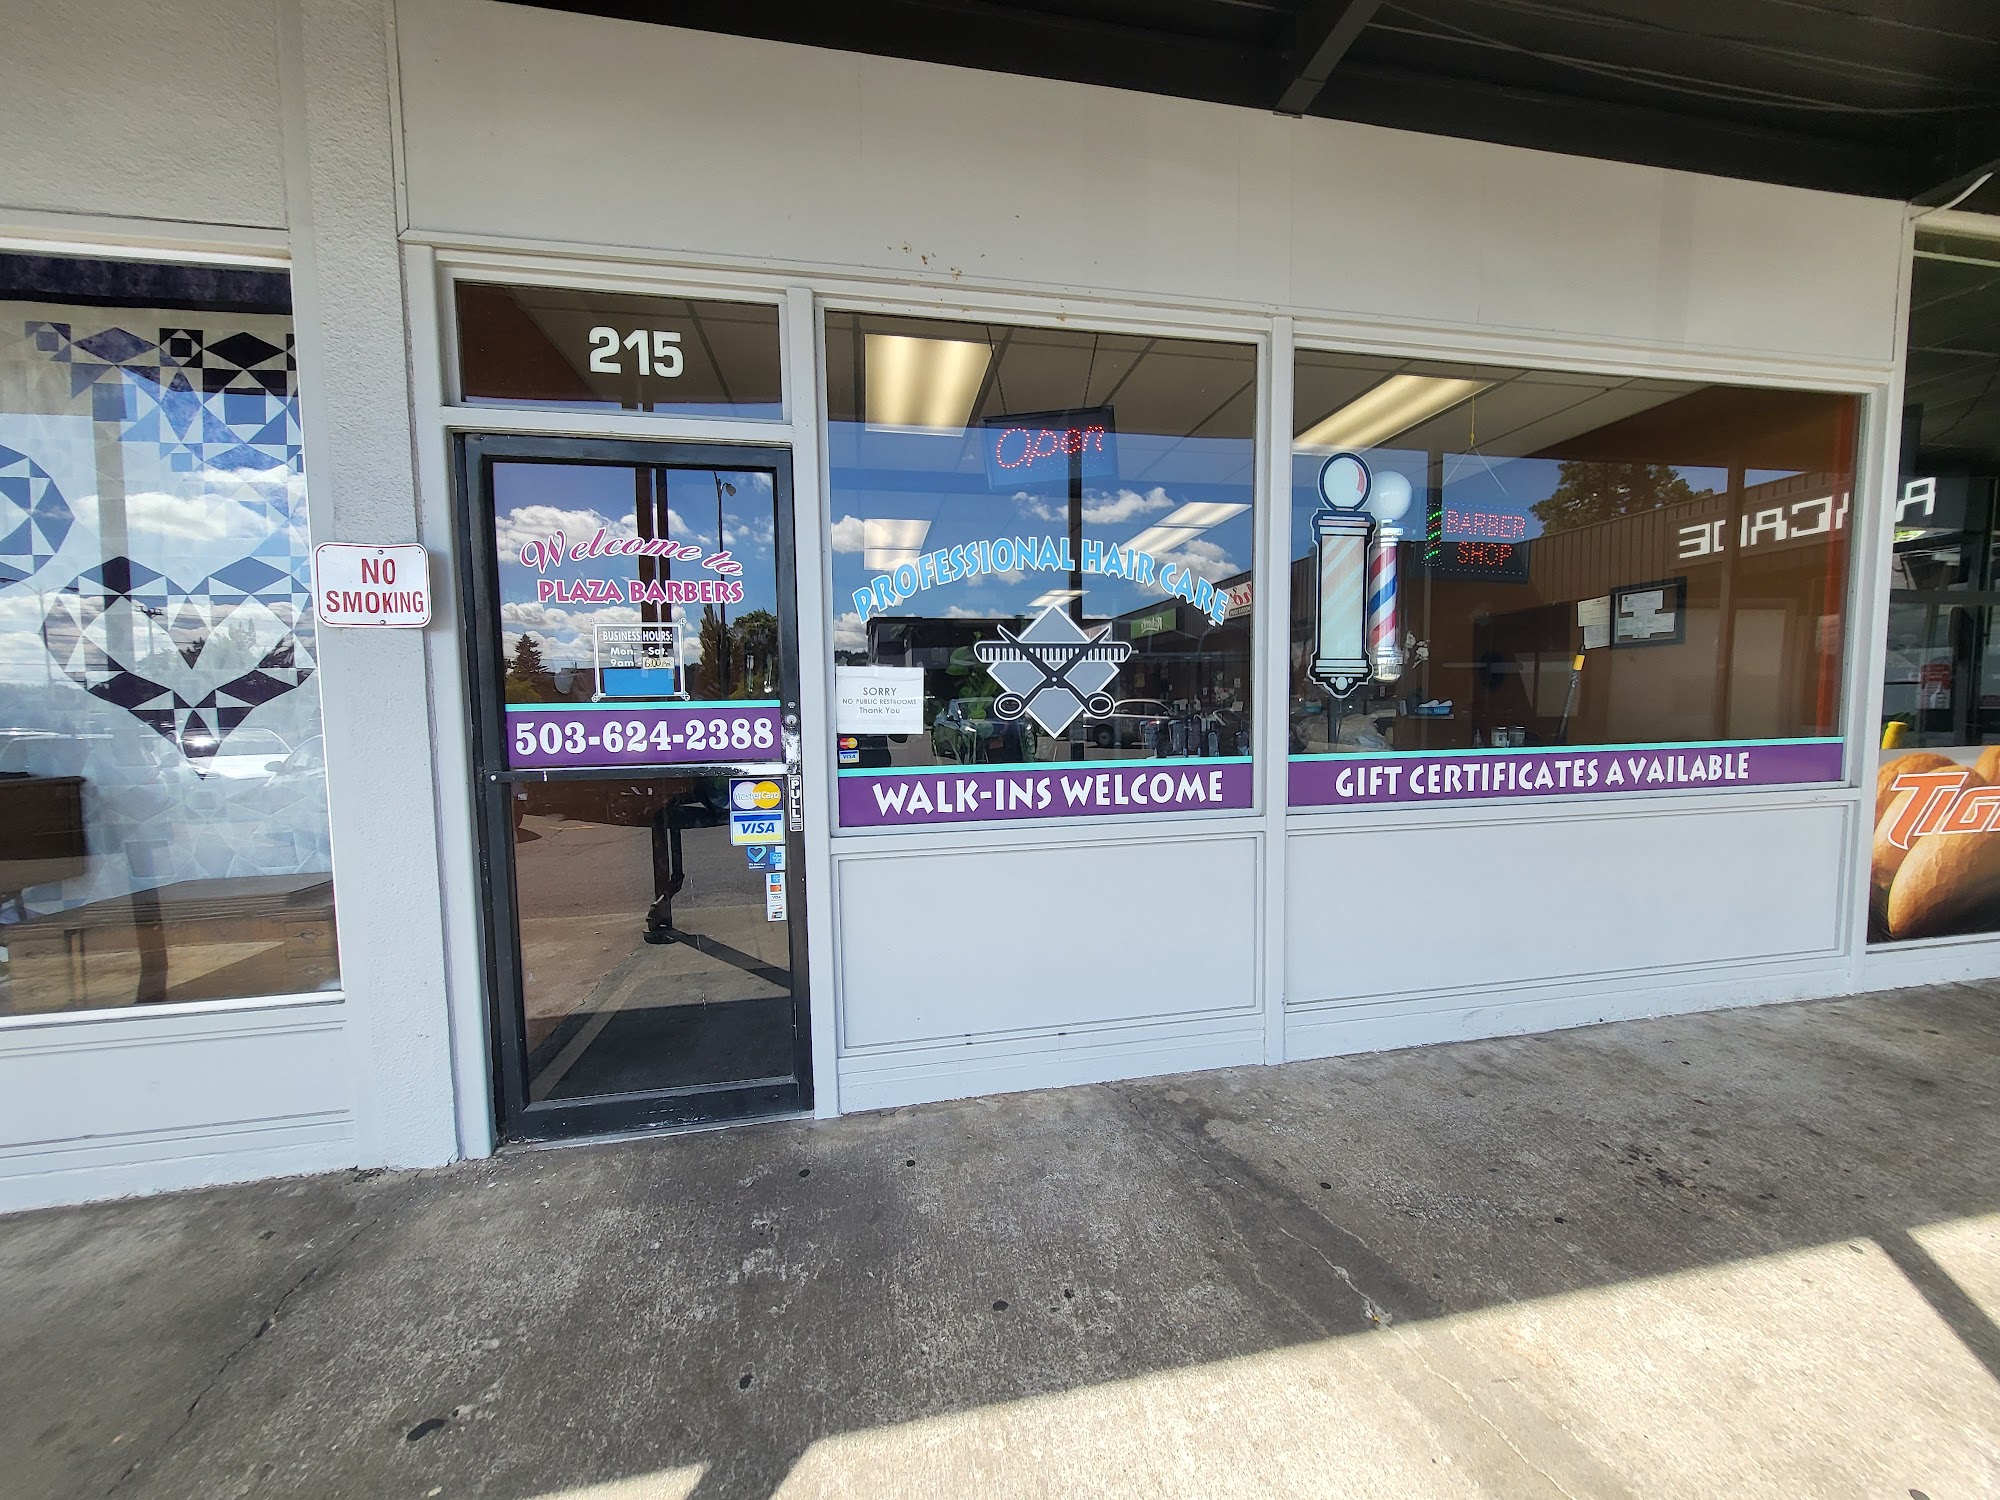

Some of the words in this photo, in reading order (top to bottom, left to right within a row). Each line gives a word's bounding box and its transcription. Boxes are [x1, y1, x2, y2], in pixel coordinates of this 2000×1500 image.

[588, 326, 684, 378] 215
[997, 426, 1105, 468] Open
[1446, 510, 1526, 538] BARBER
[520, 527, 703, 574] Welcome
[701, 550, 744, 577] to
[1457, 541, 1513, 566] SHOP
[361, 558, 396, 585] NO
[851, 535, 1076, 625] PROFESSIONAL
[1082, 538, 1155, 587] HAIR
[1159, 562, 1230, 626] CARE
[326, 590, 424, 614] SMOKING
[537, 579, 623, 604] PLAZA
[628, 579, 744, 604] BARBERS
[603, 630, 641, 641] BUSINESS
[642, 630, 673, 642] HOURS:
[610, 647, 637, 656] Mon.
[647, 647, 669, 656] Sat.
[610, 659, 635, 667] 9am
[863, 687, 897, 696] SORRY
[515, 718, 775, 755] 503-624-2388
[1335, 765, 1403, 798] GIFT
[1409, 758, 1599, 795] CERTIFICATES
[1605, 752, 1749, 787] AVAILABLE
[734, 791, 779, 801] MasterCard
[791, 779, 801, 818] PULL
[872, 776, 1052, 817] WALK-INS
[1059, 769, 1223, 808] WELCOME
[1888, 771, 2000, 850] TIG
[741, 822, 775, 835] VISA
